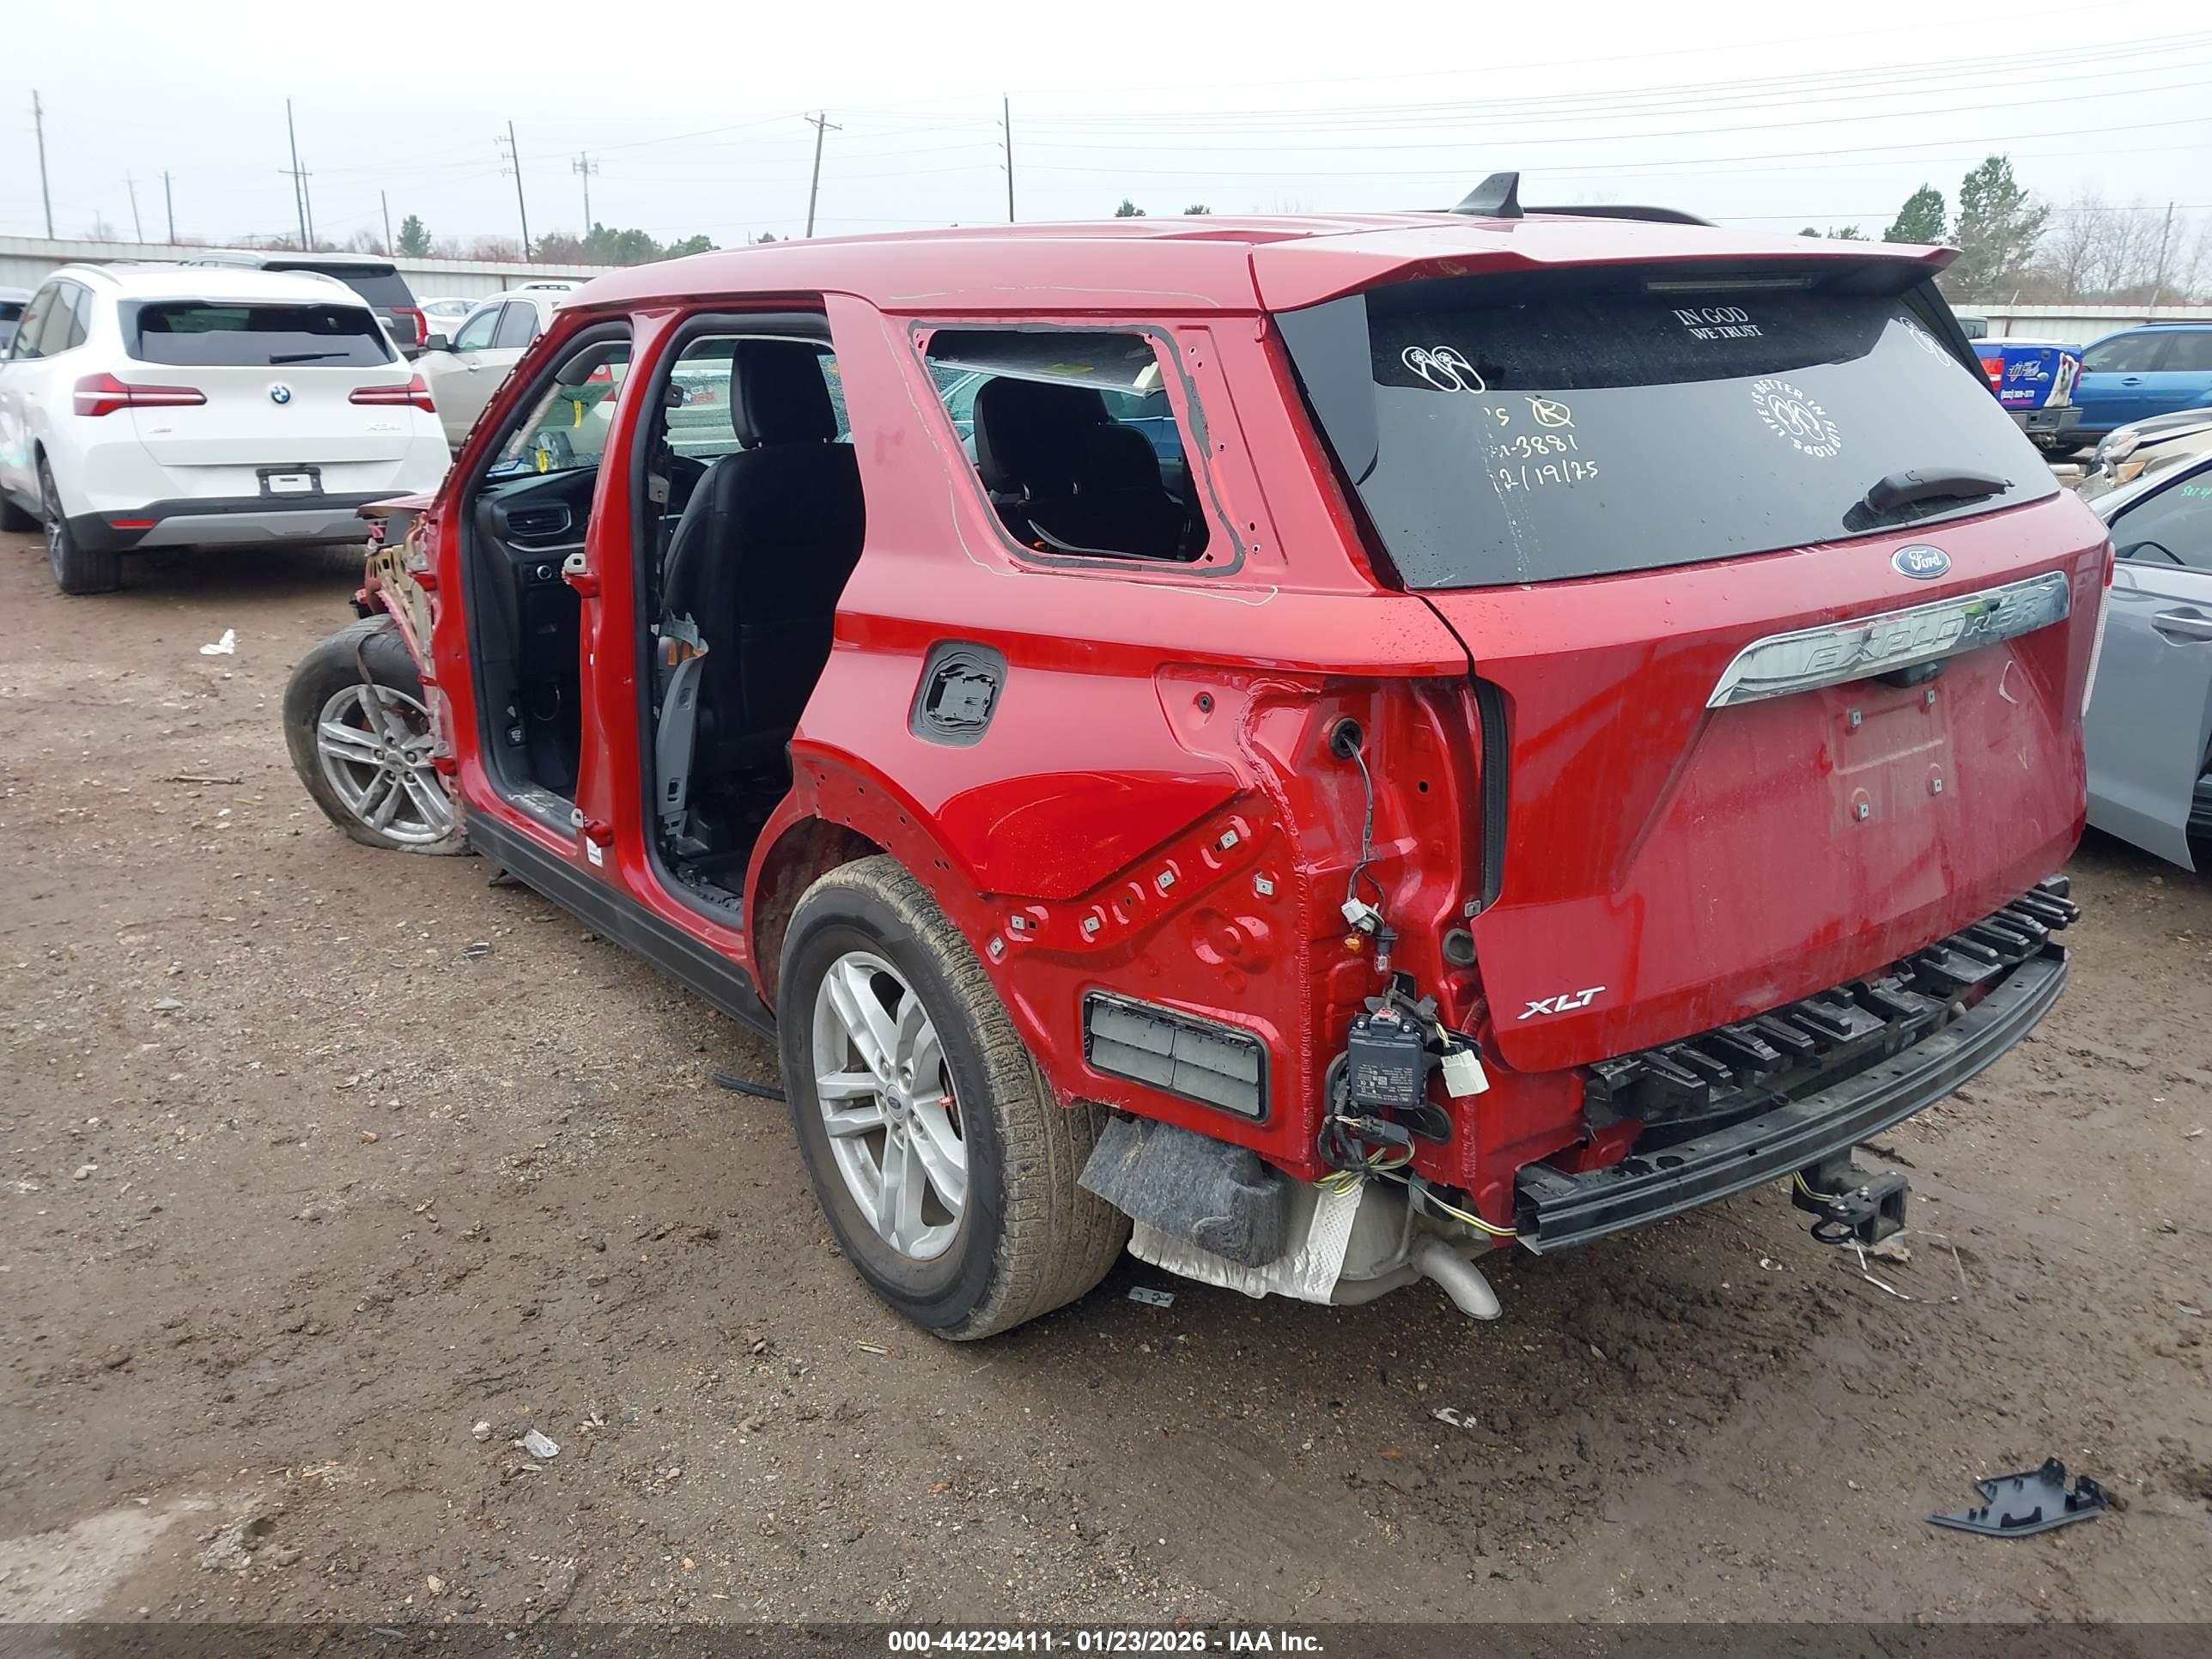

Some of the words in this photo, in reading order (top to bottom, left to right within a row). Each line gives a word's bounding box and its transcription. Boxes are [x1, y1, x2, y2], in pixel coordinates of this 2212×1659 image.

[1670, 308, 1704, 325] IN
[1701, 307, 1748, 323] GOD
[1688, 327, 1718, 339] WE
[1714, 325, 1764, 337] TRUST
[1753, 379, 1803, 399] BETTER
[1808, 400, 1826, 415] IN
[1757, 409, 1786, 437] LIFE
[1822, 419, 1842, 447] FLIP
[1908, 550, 1942, 571] Ford
[1516, 986, 1607, 1020] XLT
